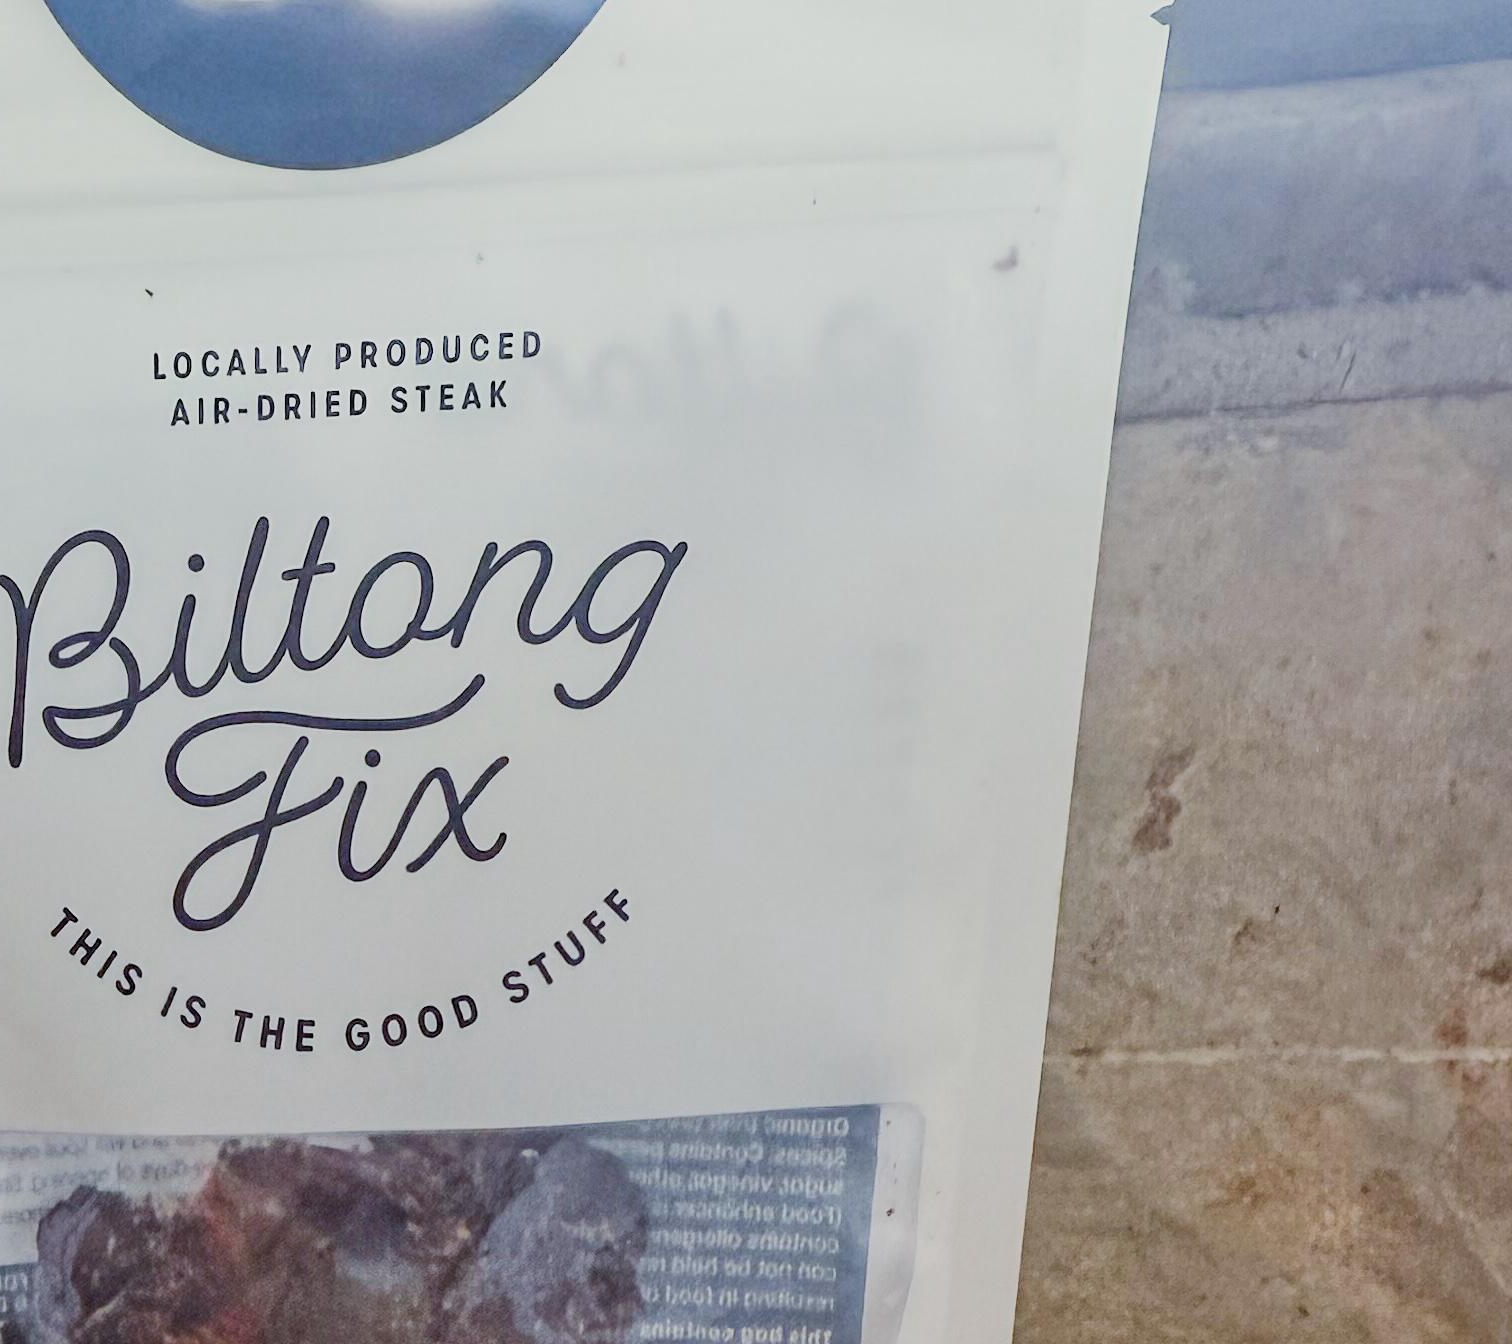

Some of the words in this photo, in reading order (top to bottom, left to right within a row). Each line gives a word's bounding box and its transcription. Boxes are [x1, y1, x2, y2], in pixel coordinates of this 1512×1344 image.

[153, 343, 312, 380] LOCALLY
[334, 330, 541, 370] PRODUCED
[170, 389, 368, 427] AIR-DRIED
[390, 379, 508, 414] STEAK
[164, 673, 510, 932] Fix
[48, 906, 144, 997] THIS
[159, 985, 207, 1030] IS
[232, 1009, 316, 1052] THE
[344, 993, 480, 1052] GOOD
[501, 888, 632, 1004] STUFF
